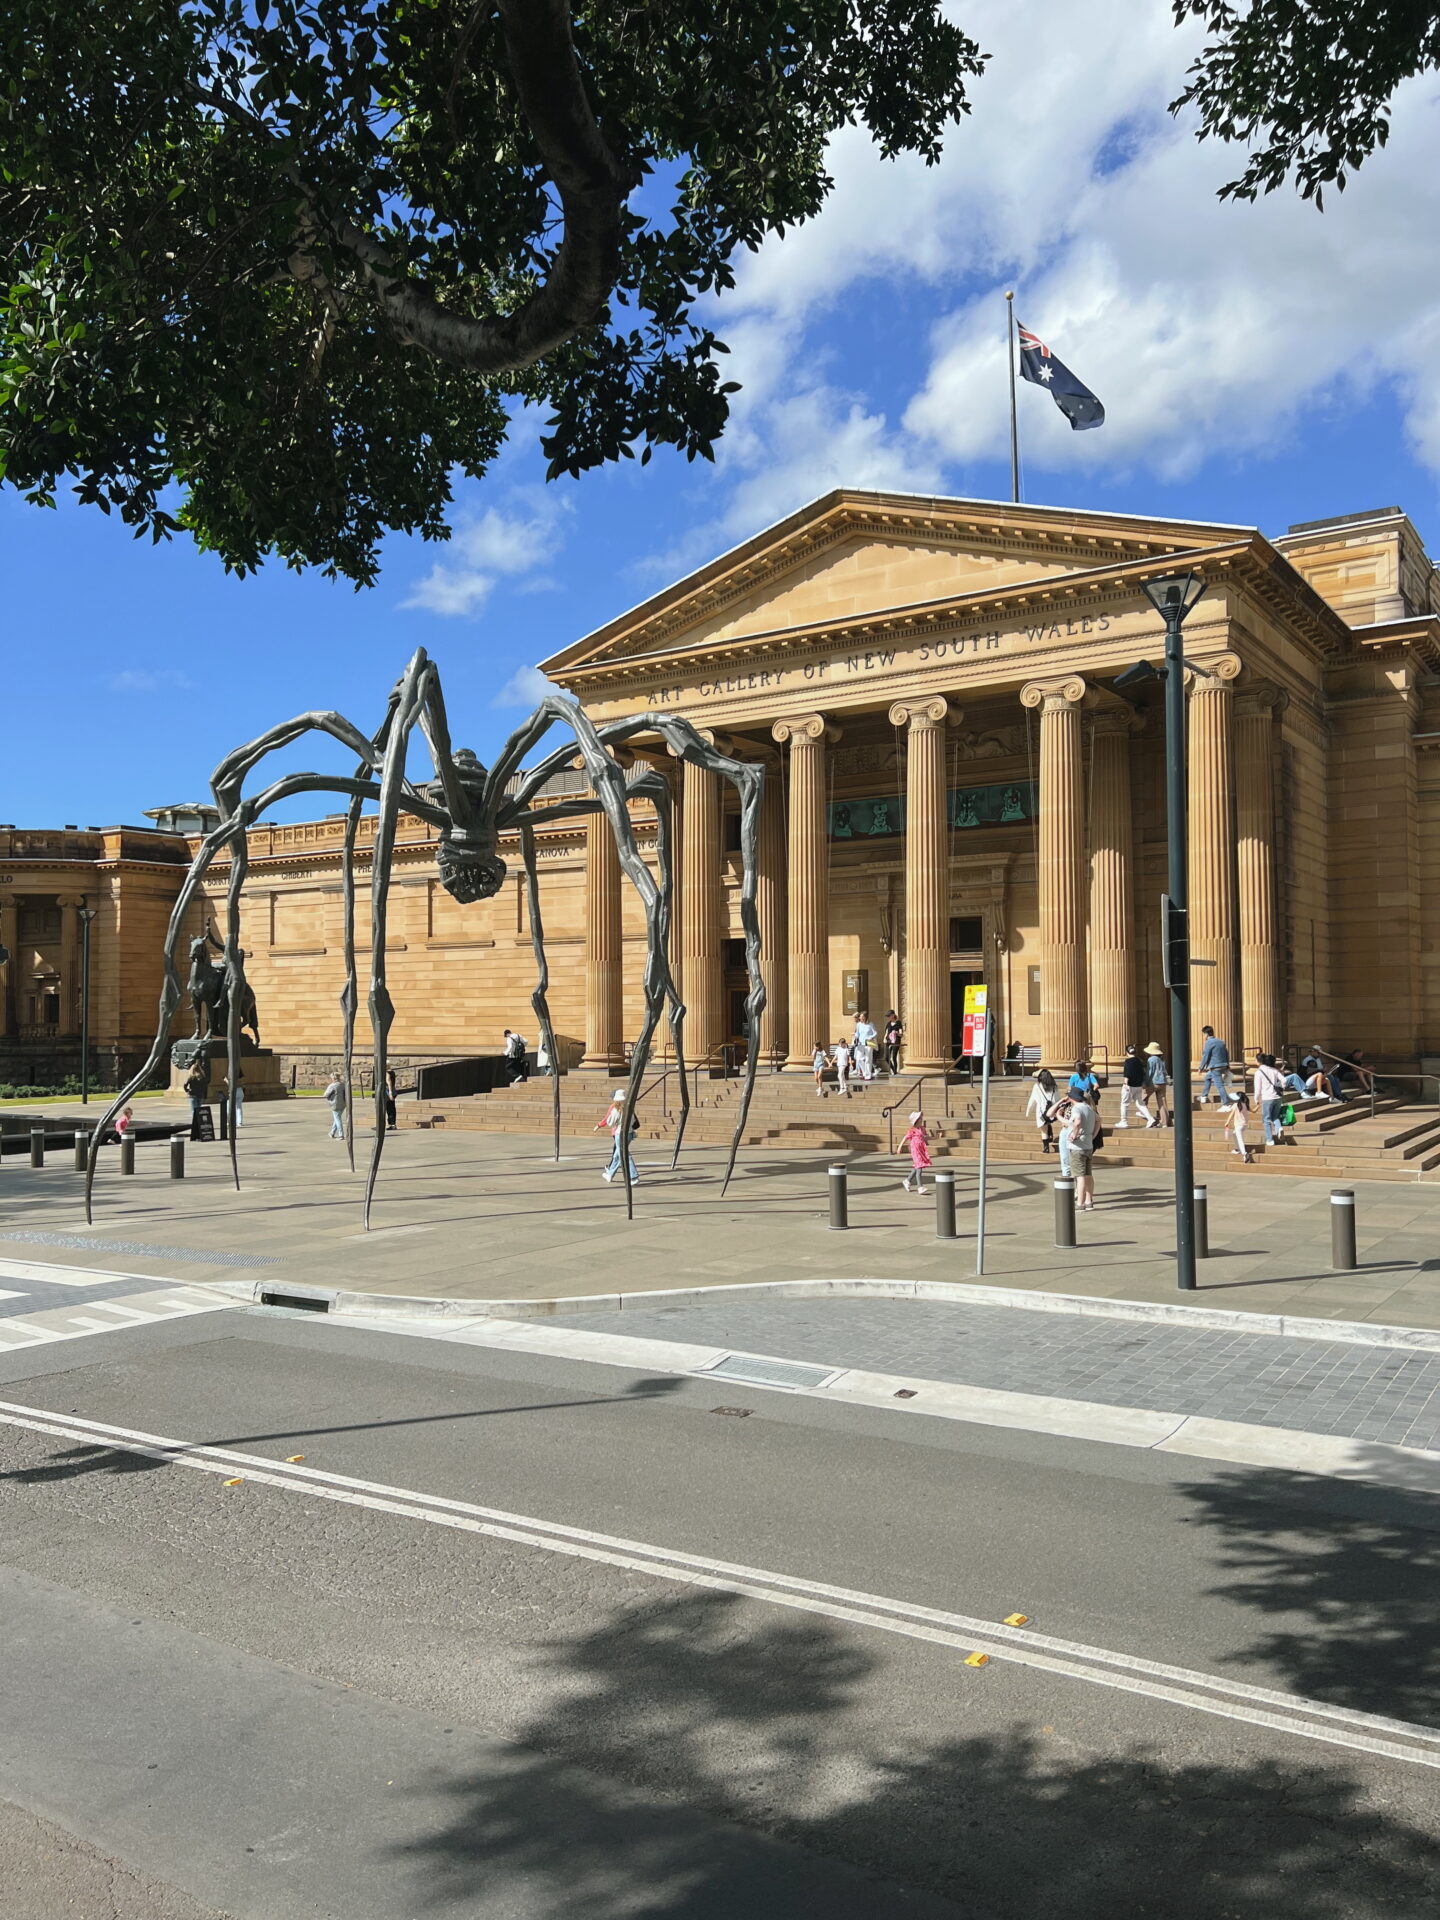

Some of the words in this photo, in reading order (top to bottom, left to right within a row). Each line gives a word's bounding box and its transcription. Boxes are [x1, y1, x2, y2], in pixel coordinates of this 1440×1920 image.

[648, 685, 682, 705] ART
[699, 667, 785, 697] GALLERY
[803, 660, 828, 680] OF
[847, 648, 897, 673] NEW
[919, 631, 999, 661] SOUTH
[1023, 611, 1110, 642] WALES
